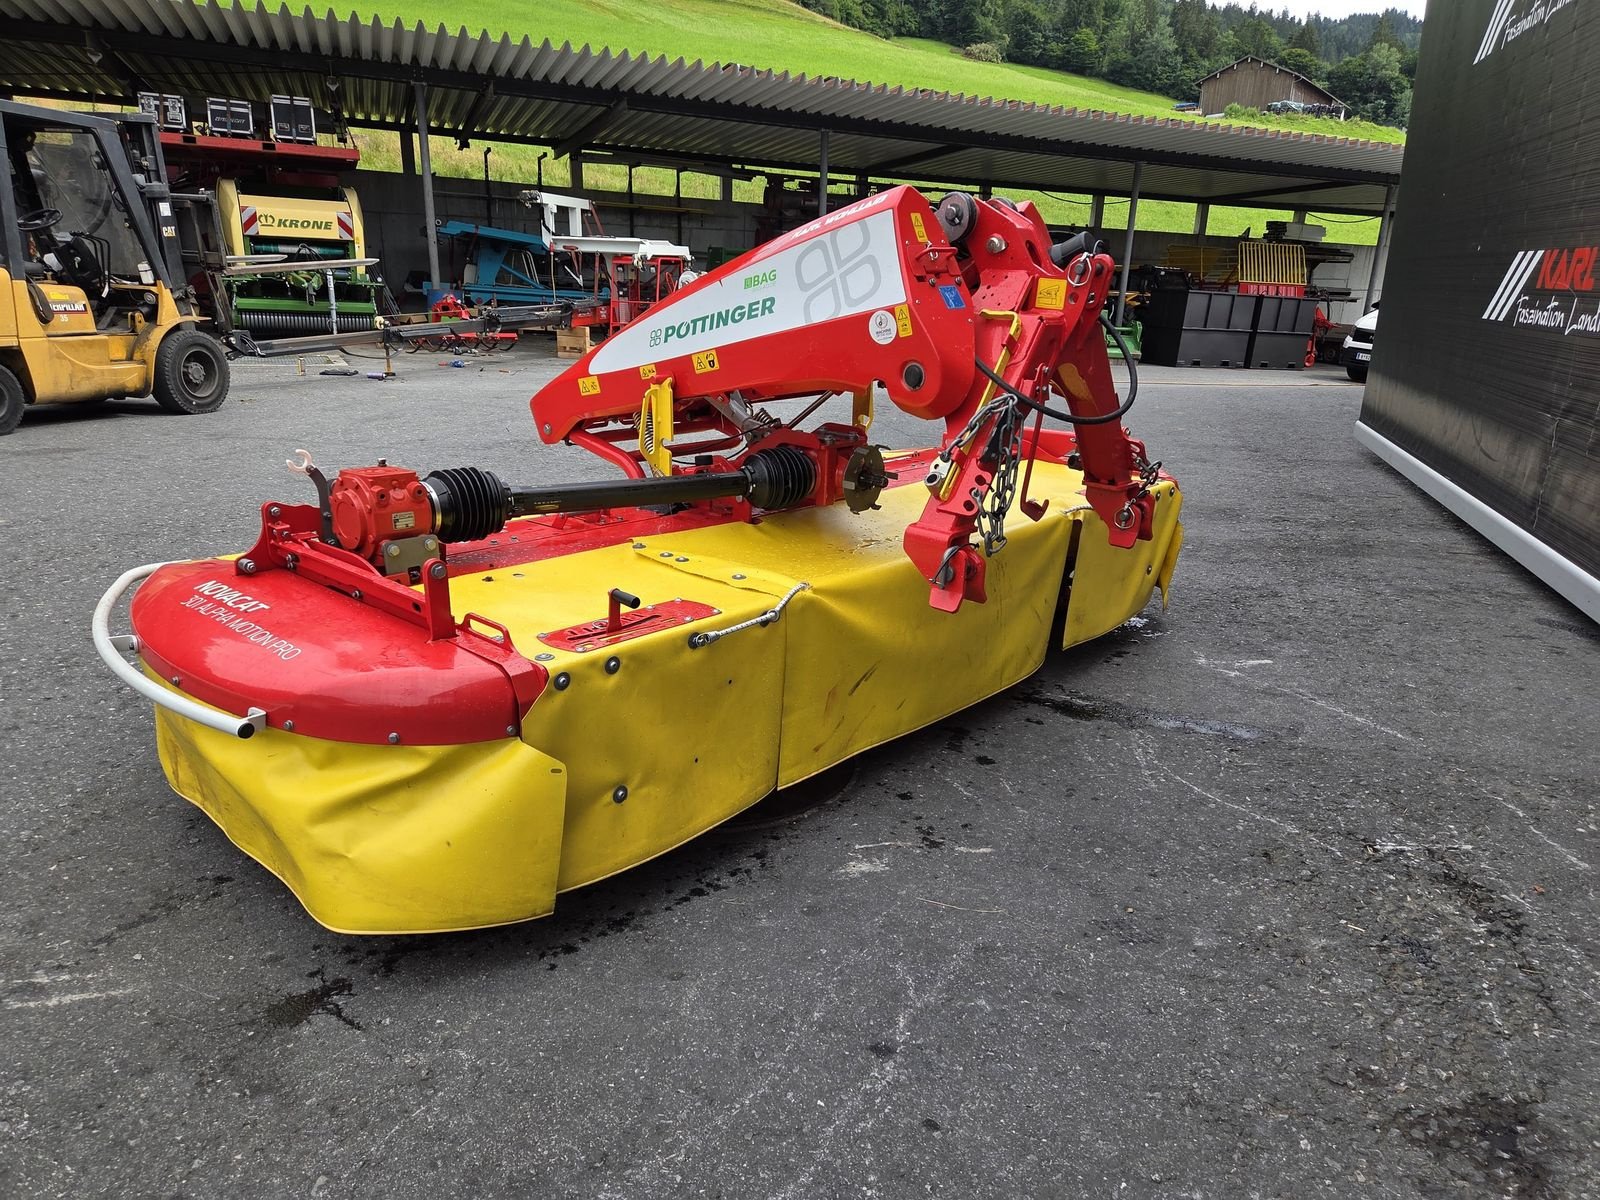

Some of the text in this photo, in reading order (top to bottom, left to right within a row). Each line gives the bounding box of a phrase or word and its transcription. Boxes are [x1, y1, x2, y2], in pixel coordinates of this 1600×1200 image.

[162, 226, 176, 237] CAT
[277, 218, 333, 230] KRONE
[752, 269, 777, 288] BAG
[1535, 247, 1598, 291] KARL
[50, 303, 86, 312] ERPILLAR
[60, 314, 69, 322] 35
[663, 296, 776, 343] PÖTTINGER
[1513, 294, 1565, 327] Faszination
[193, 580, 271, 612] NOVACAT
[180, 594, 302, 660] 301 ALPHA MOTION PRO
